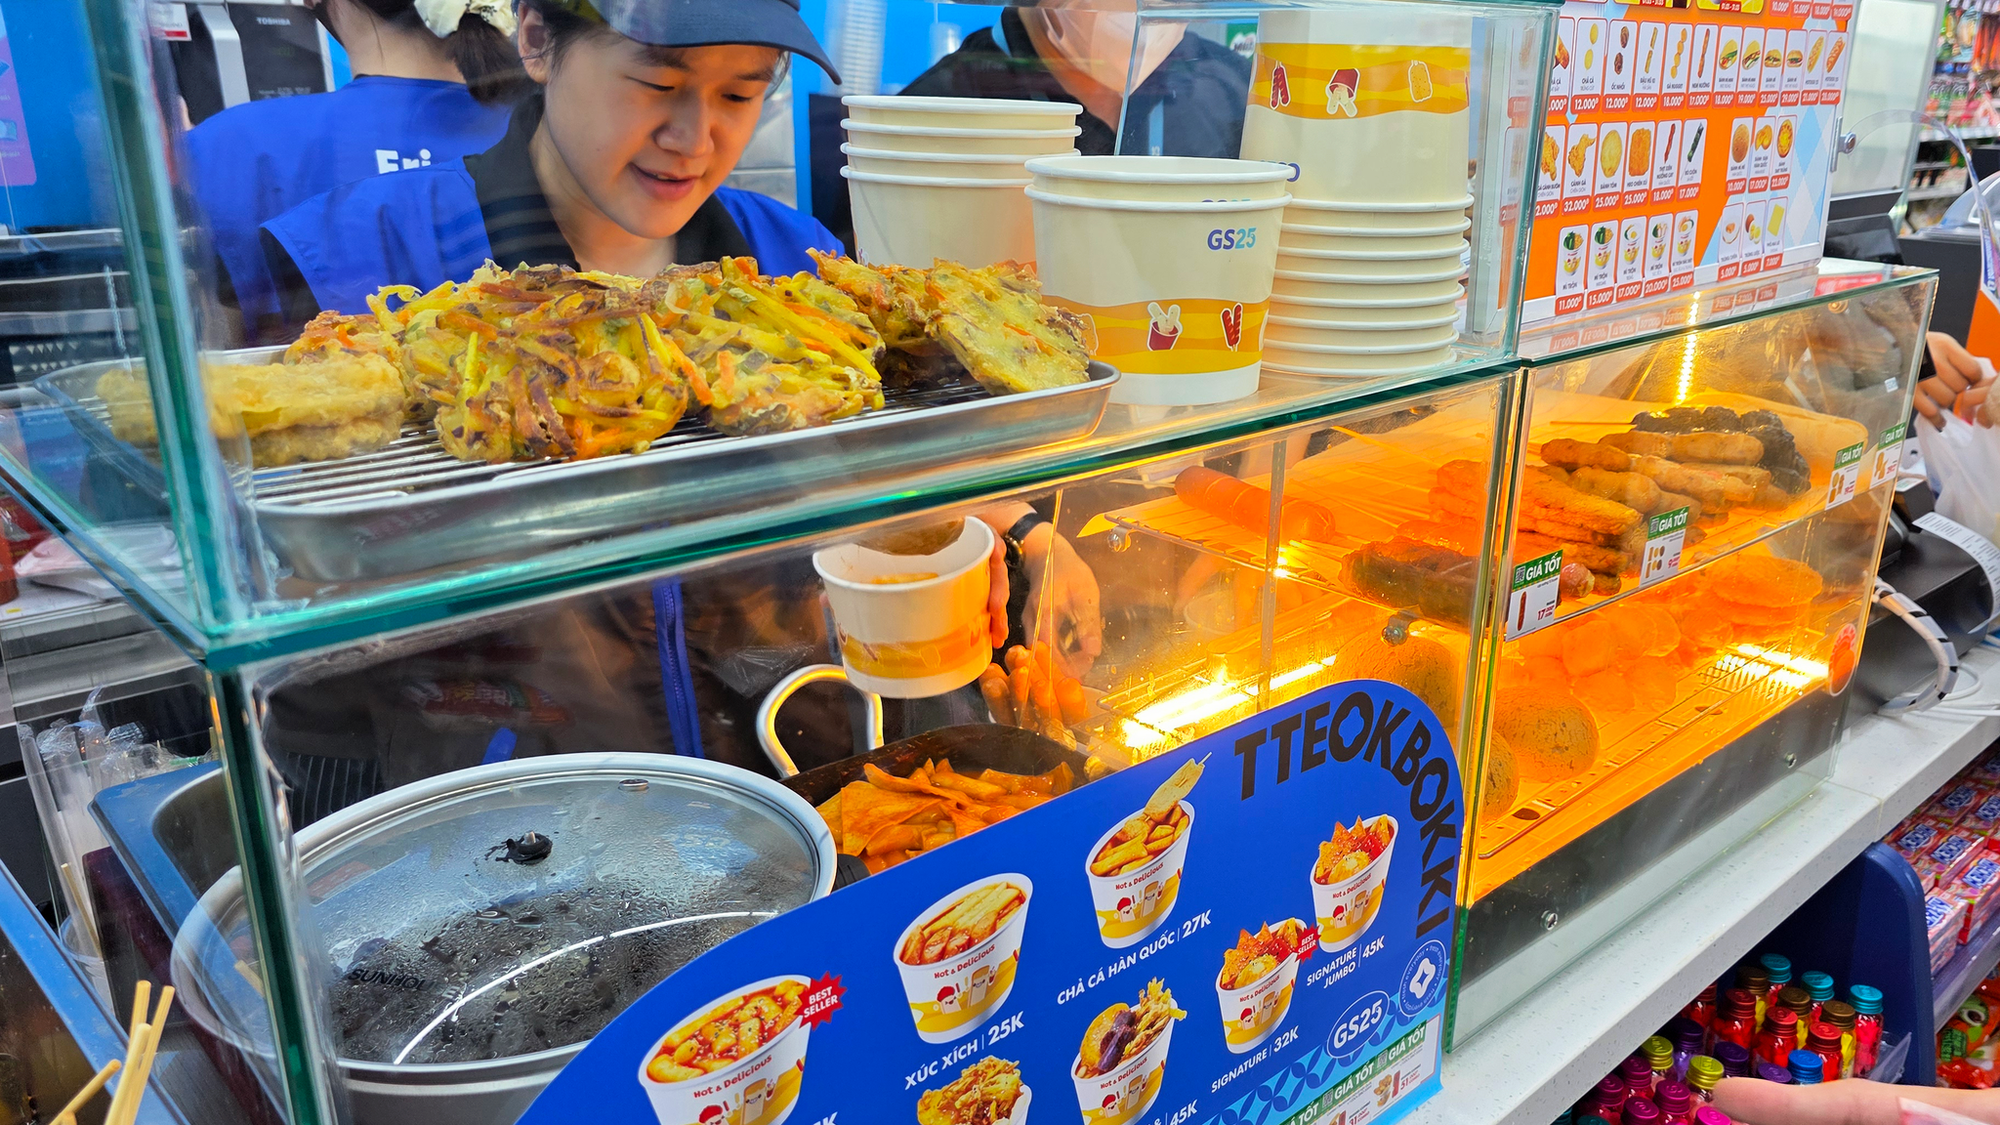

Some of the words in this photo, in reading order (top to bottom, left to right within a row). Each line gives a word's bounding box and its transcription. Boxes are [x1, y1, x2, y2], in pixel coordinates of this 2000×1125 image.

[256, 17, 291, 26] TOSHIBA
[1207, 227, 1256, 250] GS25
[1658, 514, 1673, 532] GIÁ
[1674, 508, 1688, 526] TỐT
[1526, 560, 1542, 580] GIÁ
[1544, 552, 1562, 574] TỐT
[1538, 608, 1546, 620] 17
[1234, 691, 1456, 939] TTEOKBOKKI
[1116, 882, 1128, 891] Hot
[1133, 862, 1164, 886] Delicious
[1182, 909, 1212, 939] 27K
[1298, 940, 1318, 956] SELLER
[1301, 934, 1314, 947] BEST
[1362, 936, 1385, 960] 45K
[934, 970, 950, 978] Hot
[957, 944, 996, 972] Delicious
[1057, 978, 1085, 1005] CHẢ
[1088, 968, 1106, 988] CÁ
[1108, 956, 1136, 978] HÀN
[1139, 930, 1175, 960] QUỐC
[1306, 947, 1358, 986] SIGNATURE
[1324, 962, 1356, 989] JUMBO
[803, 996, 838, 1018] SELLER
[809, 986, 832, 1005] BEST
[1334, 1000, 1382, 1048] GS25
[904, 1060, 938, 1090] XÚC
[942, 1039, 978, 1070] XÍCH
[988, 1010, 1024, 1046] 25K
[1388, 1036, 1406, 1060] GIÁ
[1408, 1024, 1426, 1047] TỐT
[1101, 1080, 1112, 1090] Hot
[1118, 1057, 1148, 1082] Delicious
[1211, 1048, 1268, 1094] SIGNATURE
[1274, 1025, 1299, 1052] 32K
[694, 1087, 712, 1098] Hot
[724, 1055, 772, 1090] Delicious
[1334, 1074, 1353, 1100] GIÁ
[1356, 1060, 1374, 1085] TỐT
[1170, 1099, 1198, 1125] 45K
[1298, 1102, 1319, 1125] TỐT
